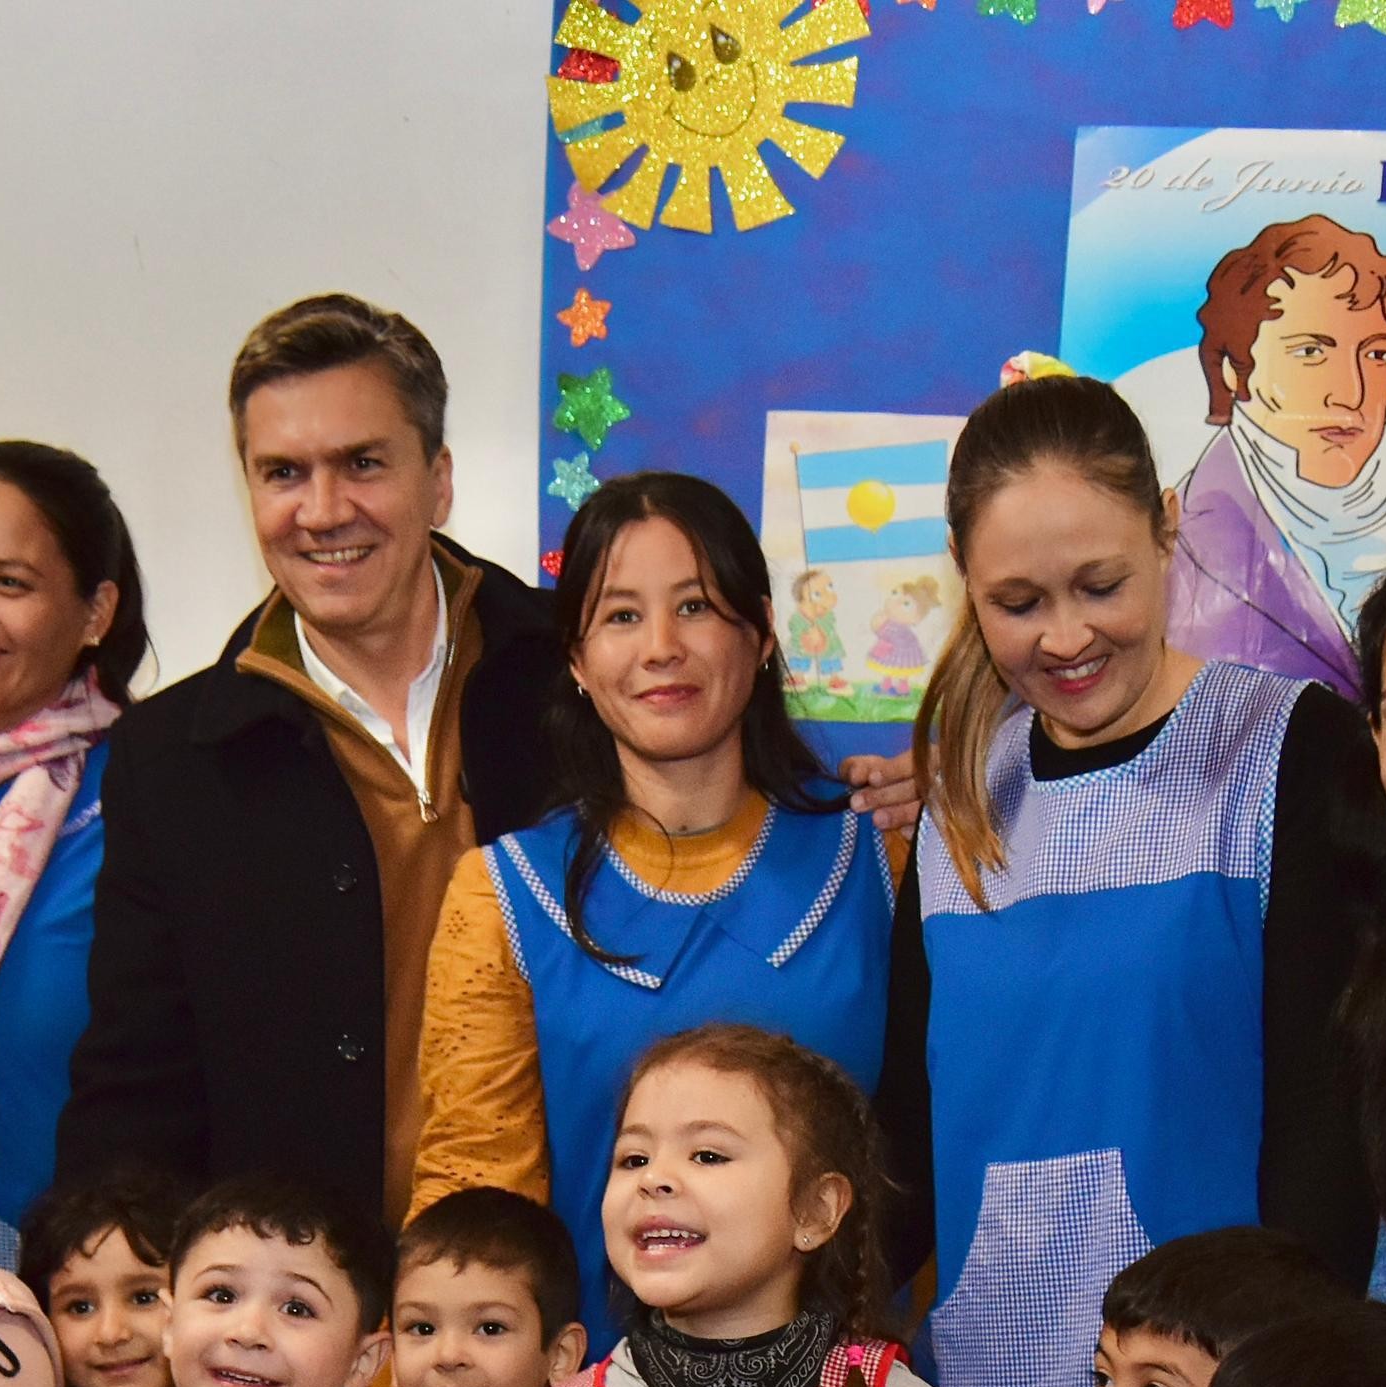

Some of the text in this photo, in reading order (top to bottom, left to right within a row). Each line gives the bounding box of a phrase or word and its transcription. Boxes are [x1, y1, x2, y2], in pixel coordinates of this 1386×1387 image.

[1102, 156, 1156, 190] 20
[1163, 157, 1213, 192] de
[1201, 159, 1366, 213] Junio
